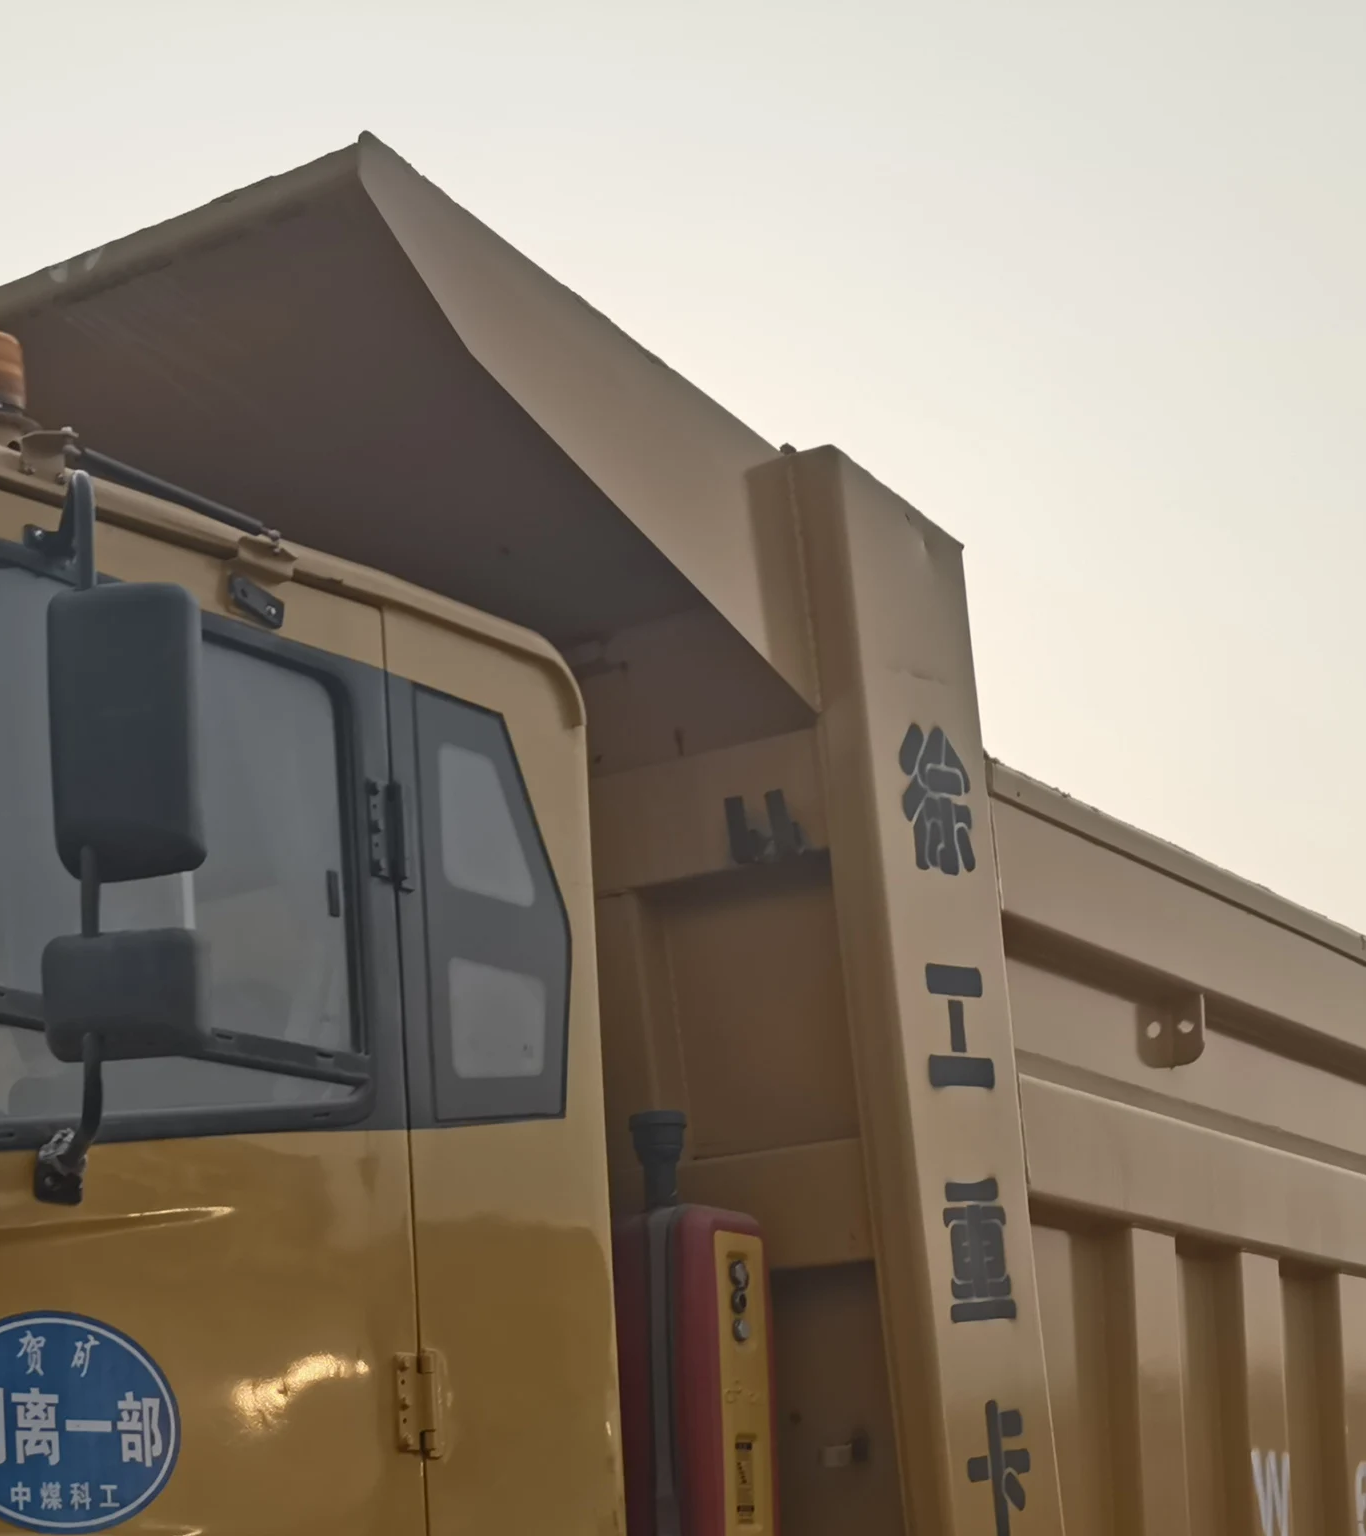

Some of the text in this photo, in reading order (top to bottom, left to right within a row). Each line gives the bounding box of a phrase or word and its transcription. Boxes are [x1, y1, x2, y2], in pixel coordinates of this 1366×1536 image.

[17, 1330, 100, 1377] 贺矿
[10, 1481, 120, 1511] 中煤科工
